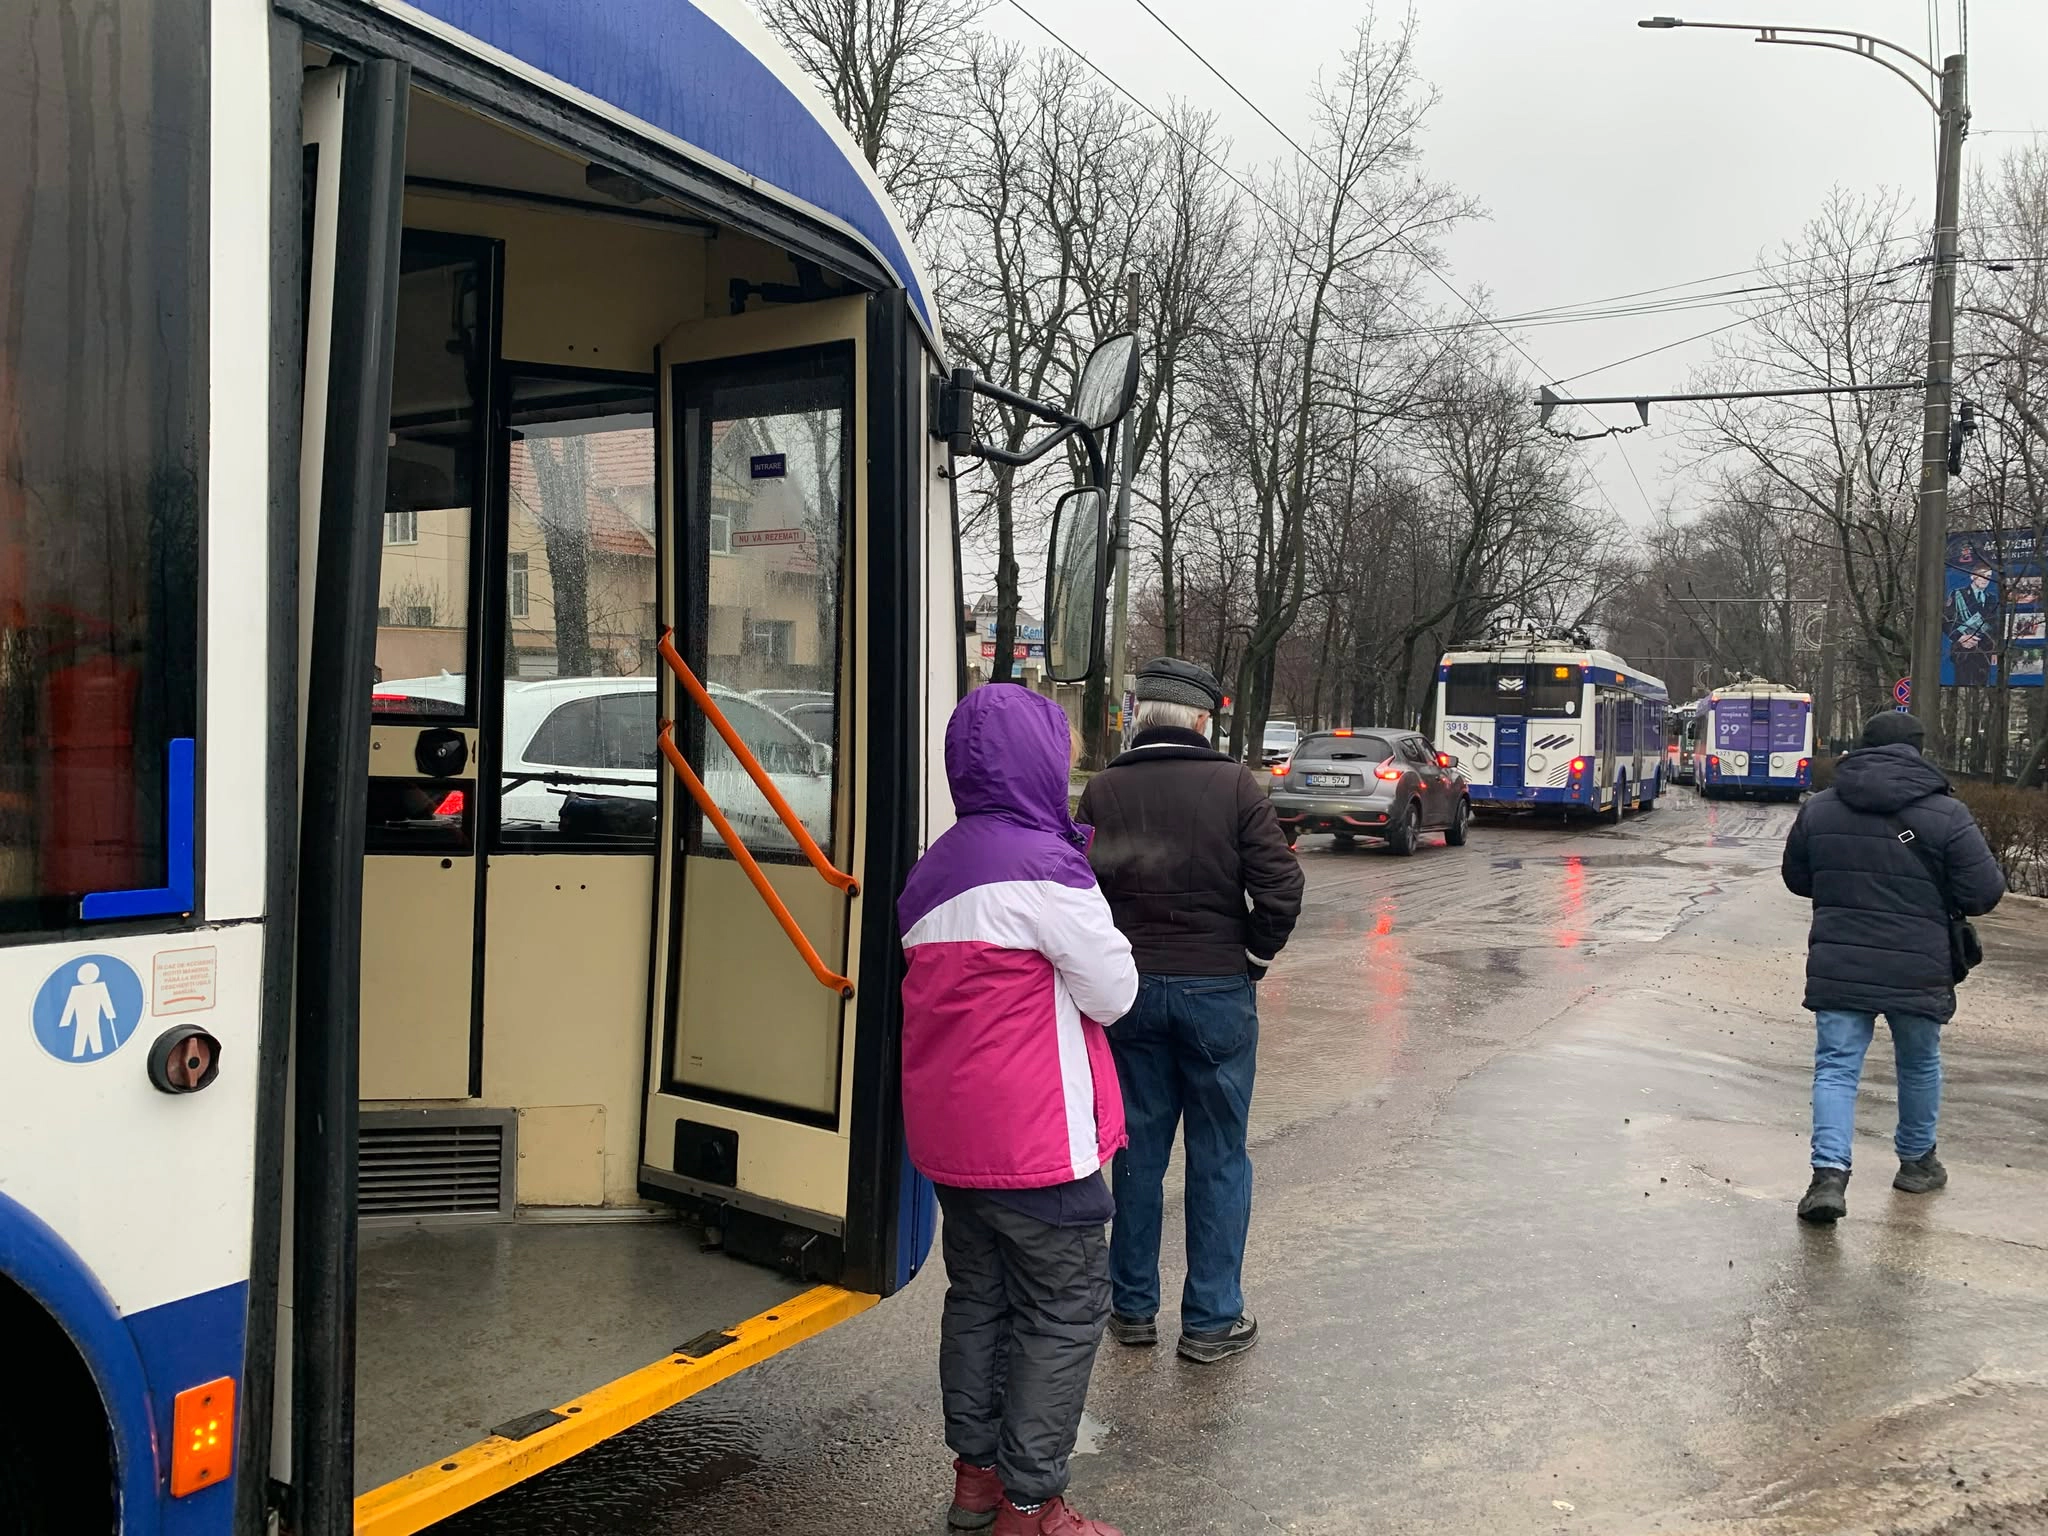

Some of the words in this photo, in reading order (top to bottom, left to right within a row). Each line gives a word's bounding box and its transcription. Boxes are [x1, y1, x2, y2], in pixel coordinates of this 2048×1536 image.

[754, 462, 782, 471] INTRARE
[739, 535, 749, 544] NU
[1446, 722, 1469, 731] 3918
[1720, 723, 1740, 735] 99
[1331, 776, 1345, 784] 574
